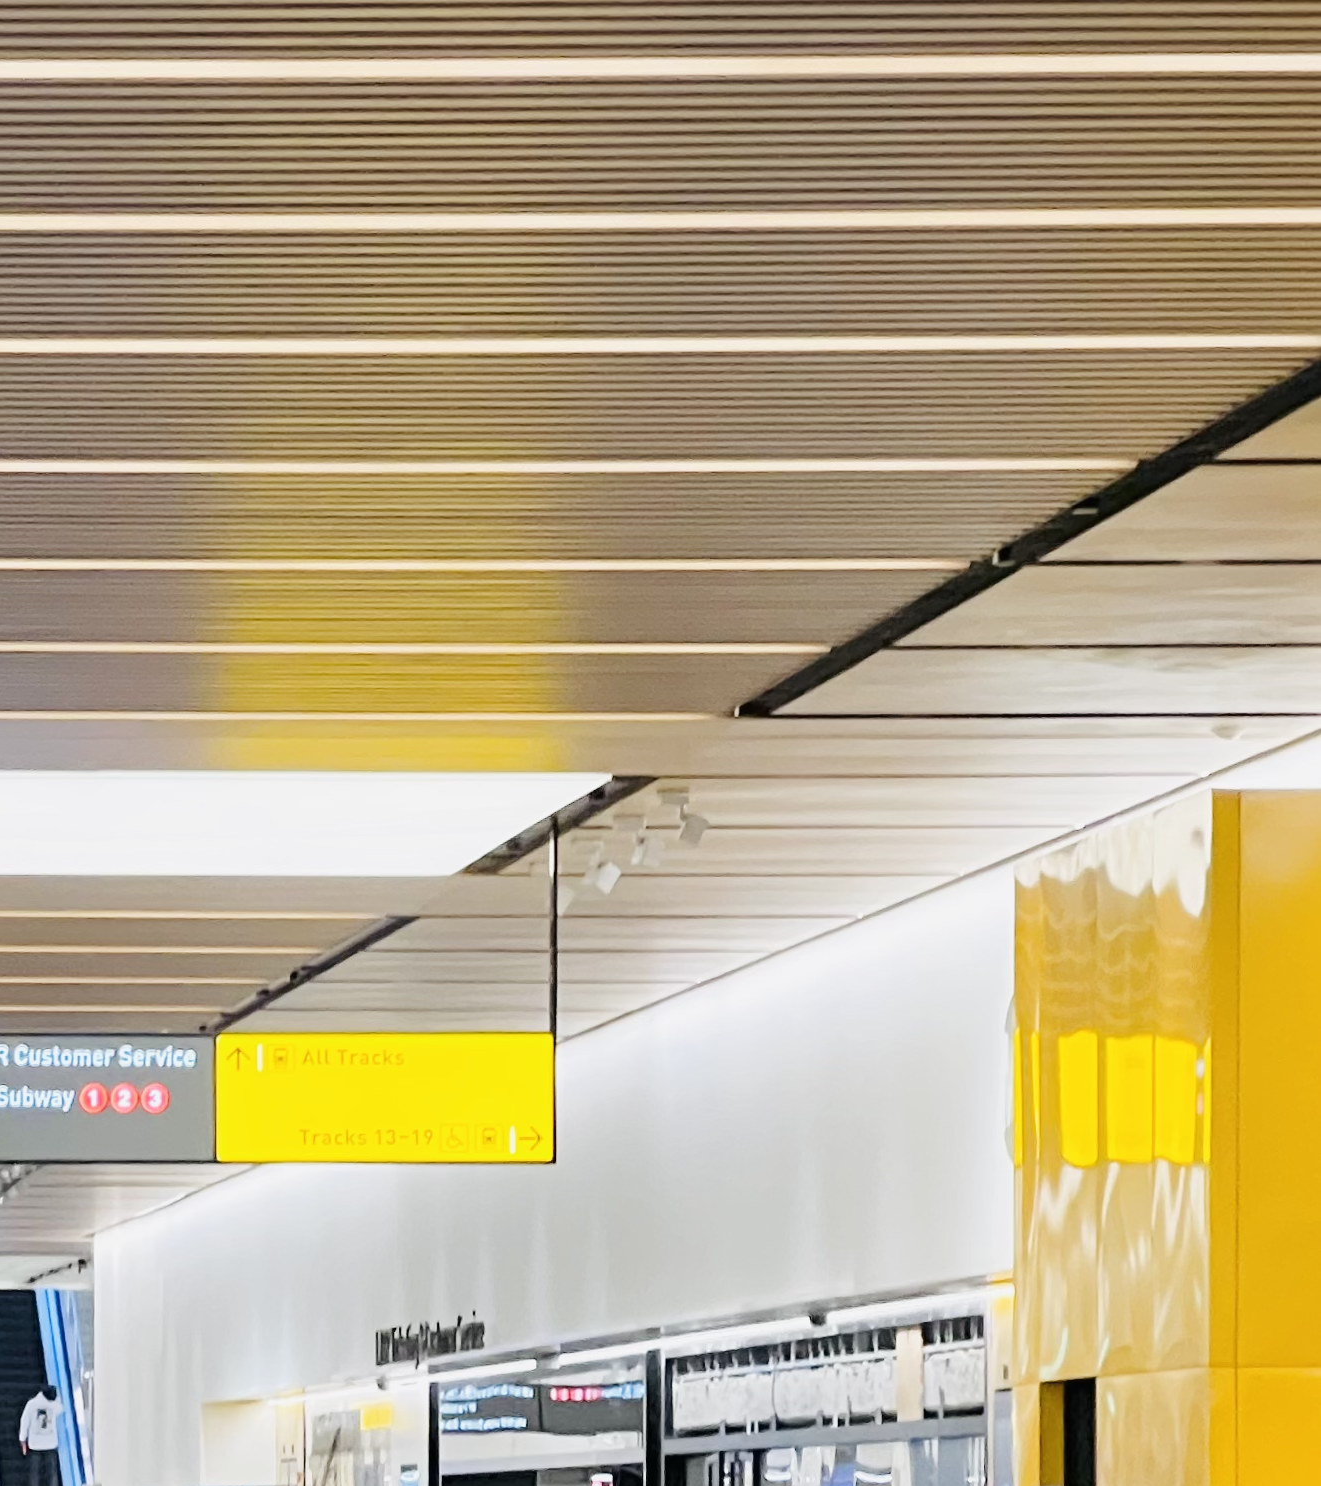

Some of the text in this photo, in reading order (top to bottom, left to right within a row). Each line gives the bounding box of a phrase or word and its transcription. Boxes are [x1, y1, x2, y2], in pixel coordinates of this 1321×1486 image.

[13, 1045, 114, 1068] Customer
[118, 1045, 196, 1068] Service
[302, 1049, 404, 1067] All Tracks
[299, 1129, 433, 1147] Tracks 13-19
